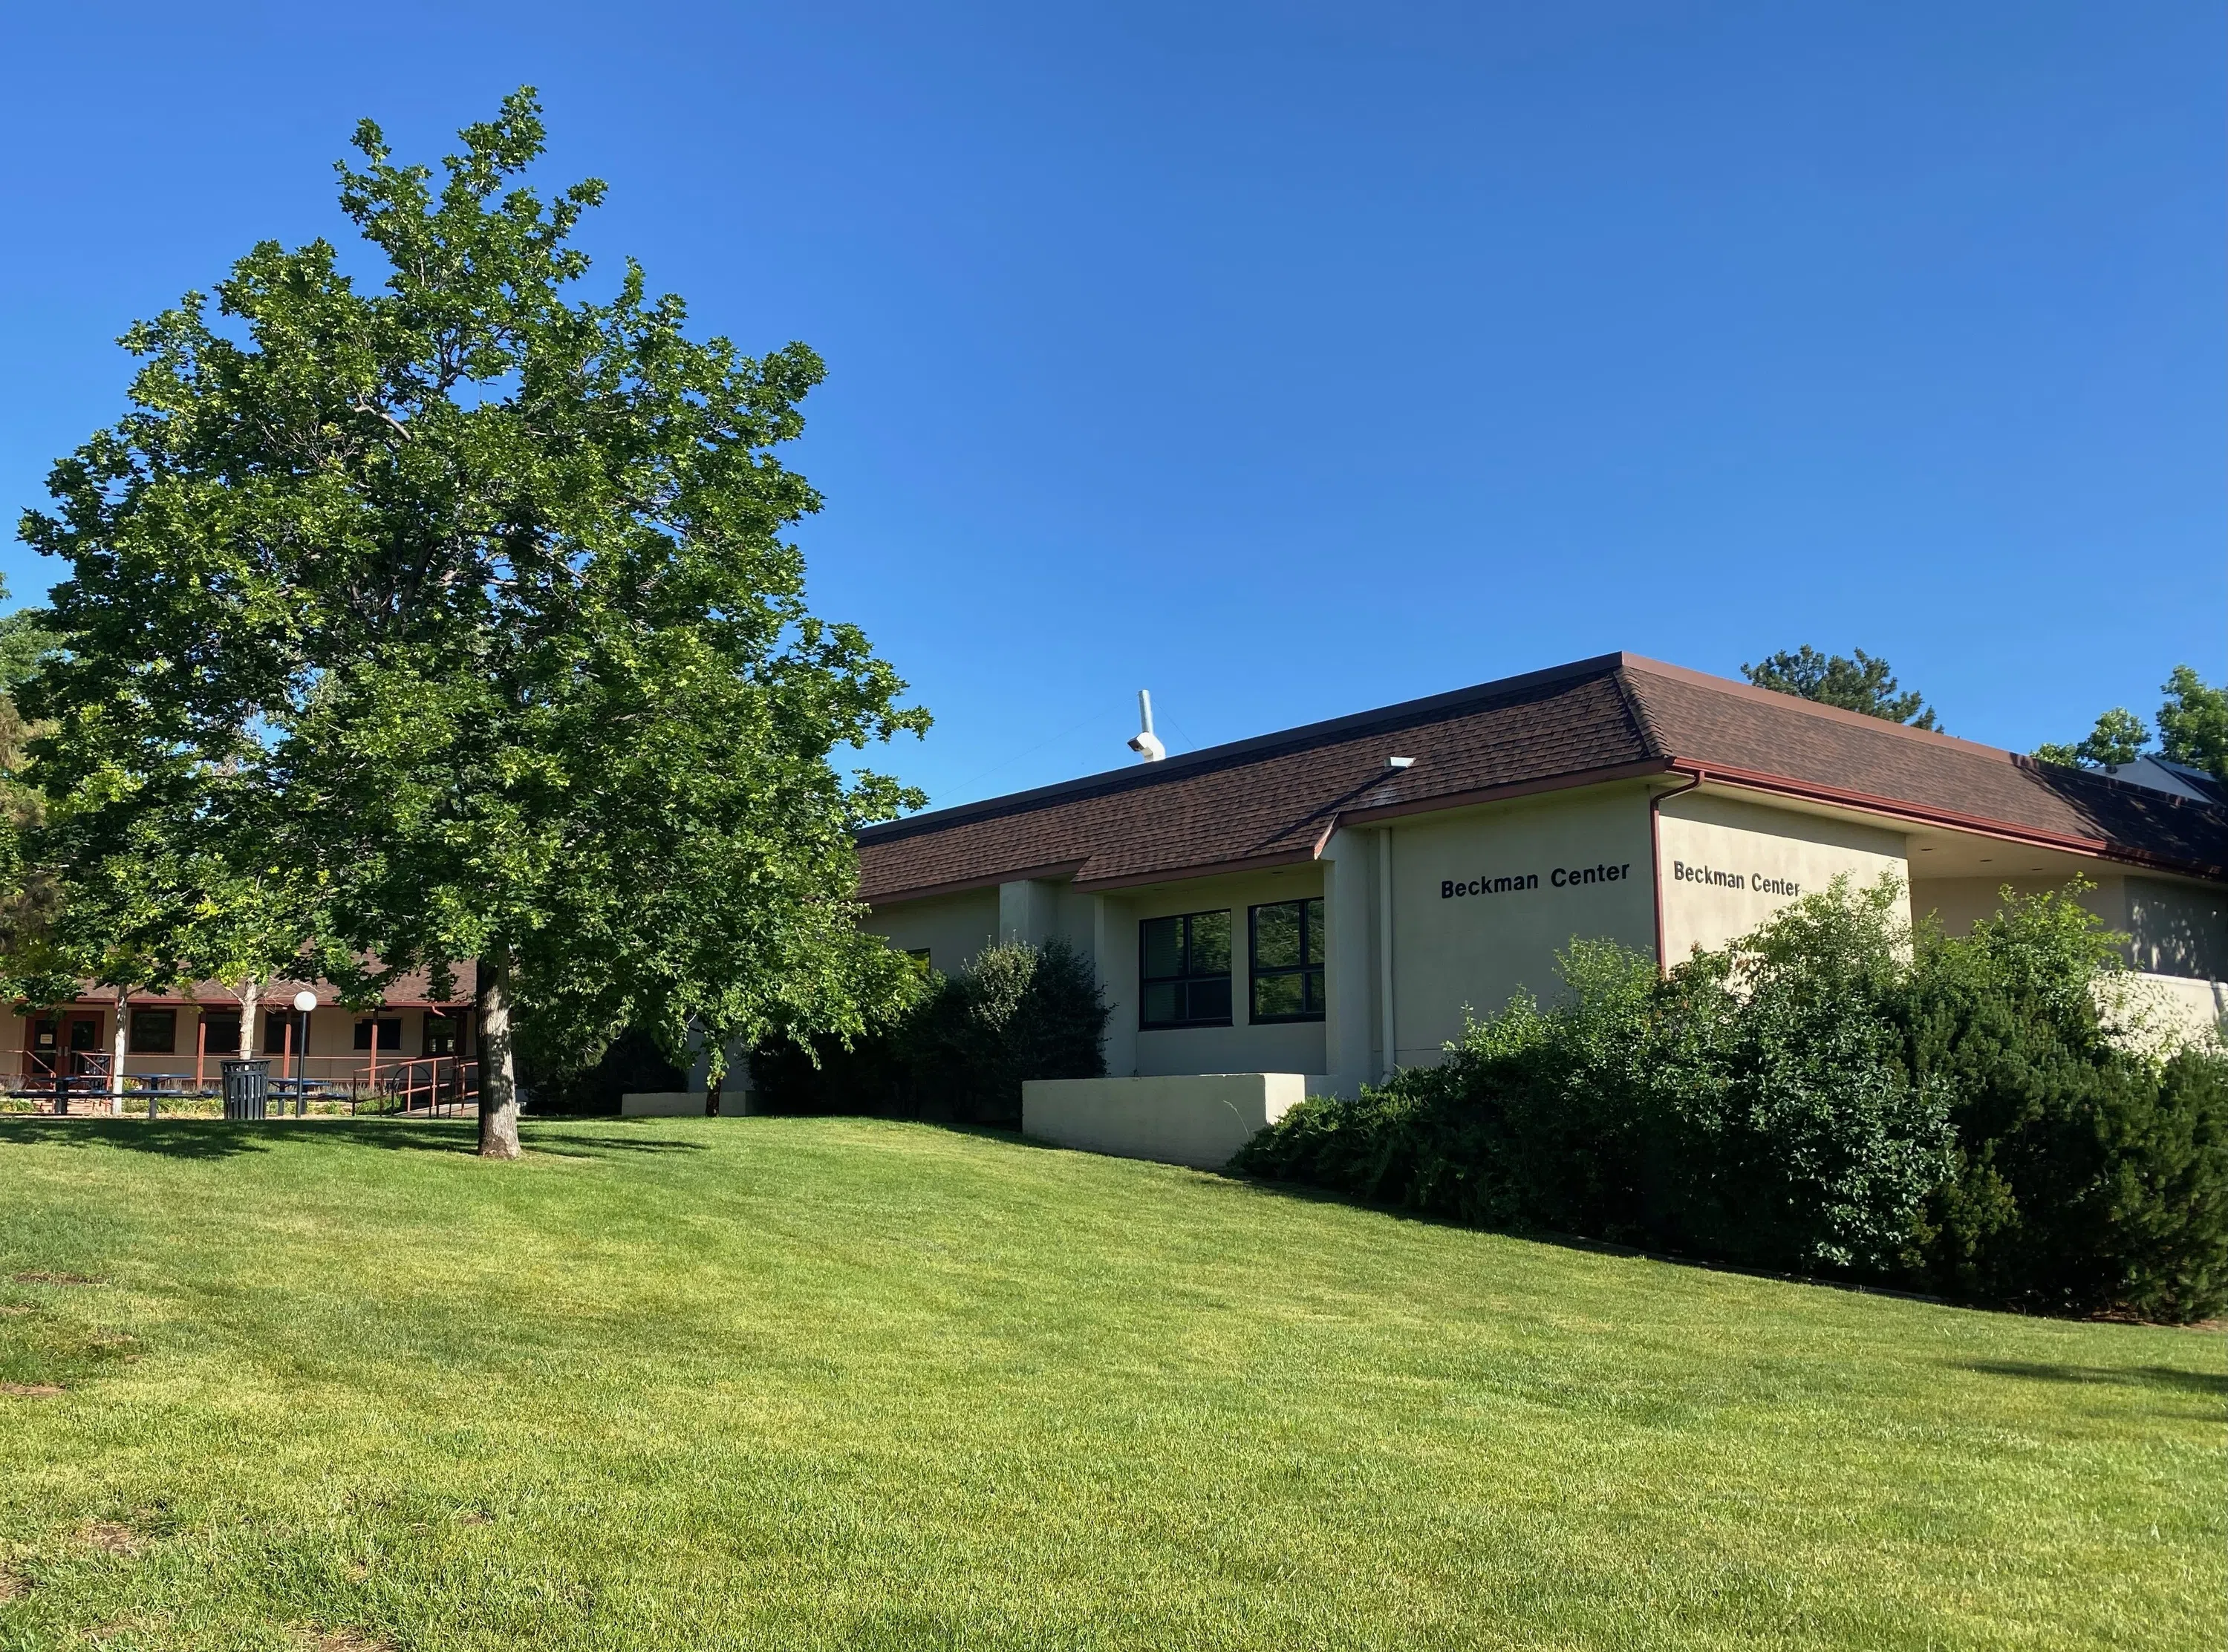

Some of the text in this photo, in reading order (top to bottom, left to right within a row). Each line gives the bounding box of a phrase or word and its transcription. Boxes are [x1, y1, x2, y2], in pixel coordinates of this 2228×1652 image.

[1441, 863, 1630, 899] Beckman Center
[1673, 860, 1800, 897] Beckman Center
